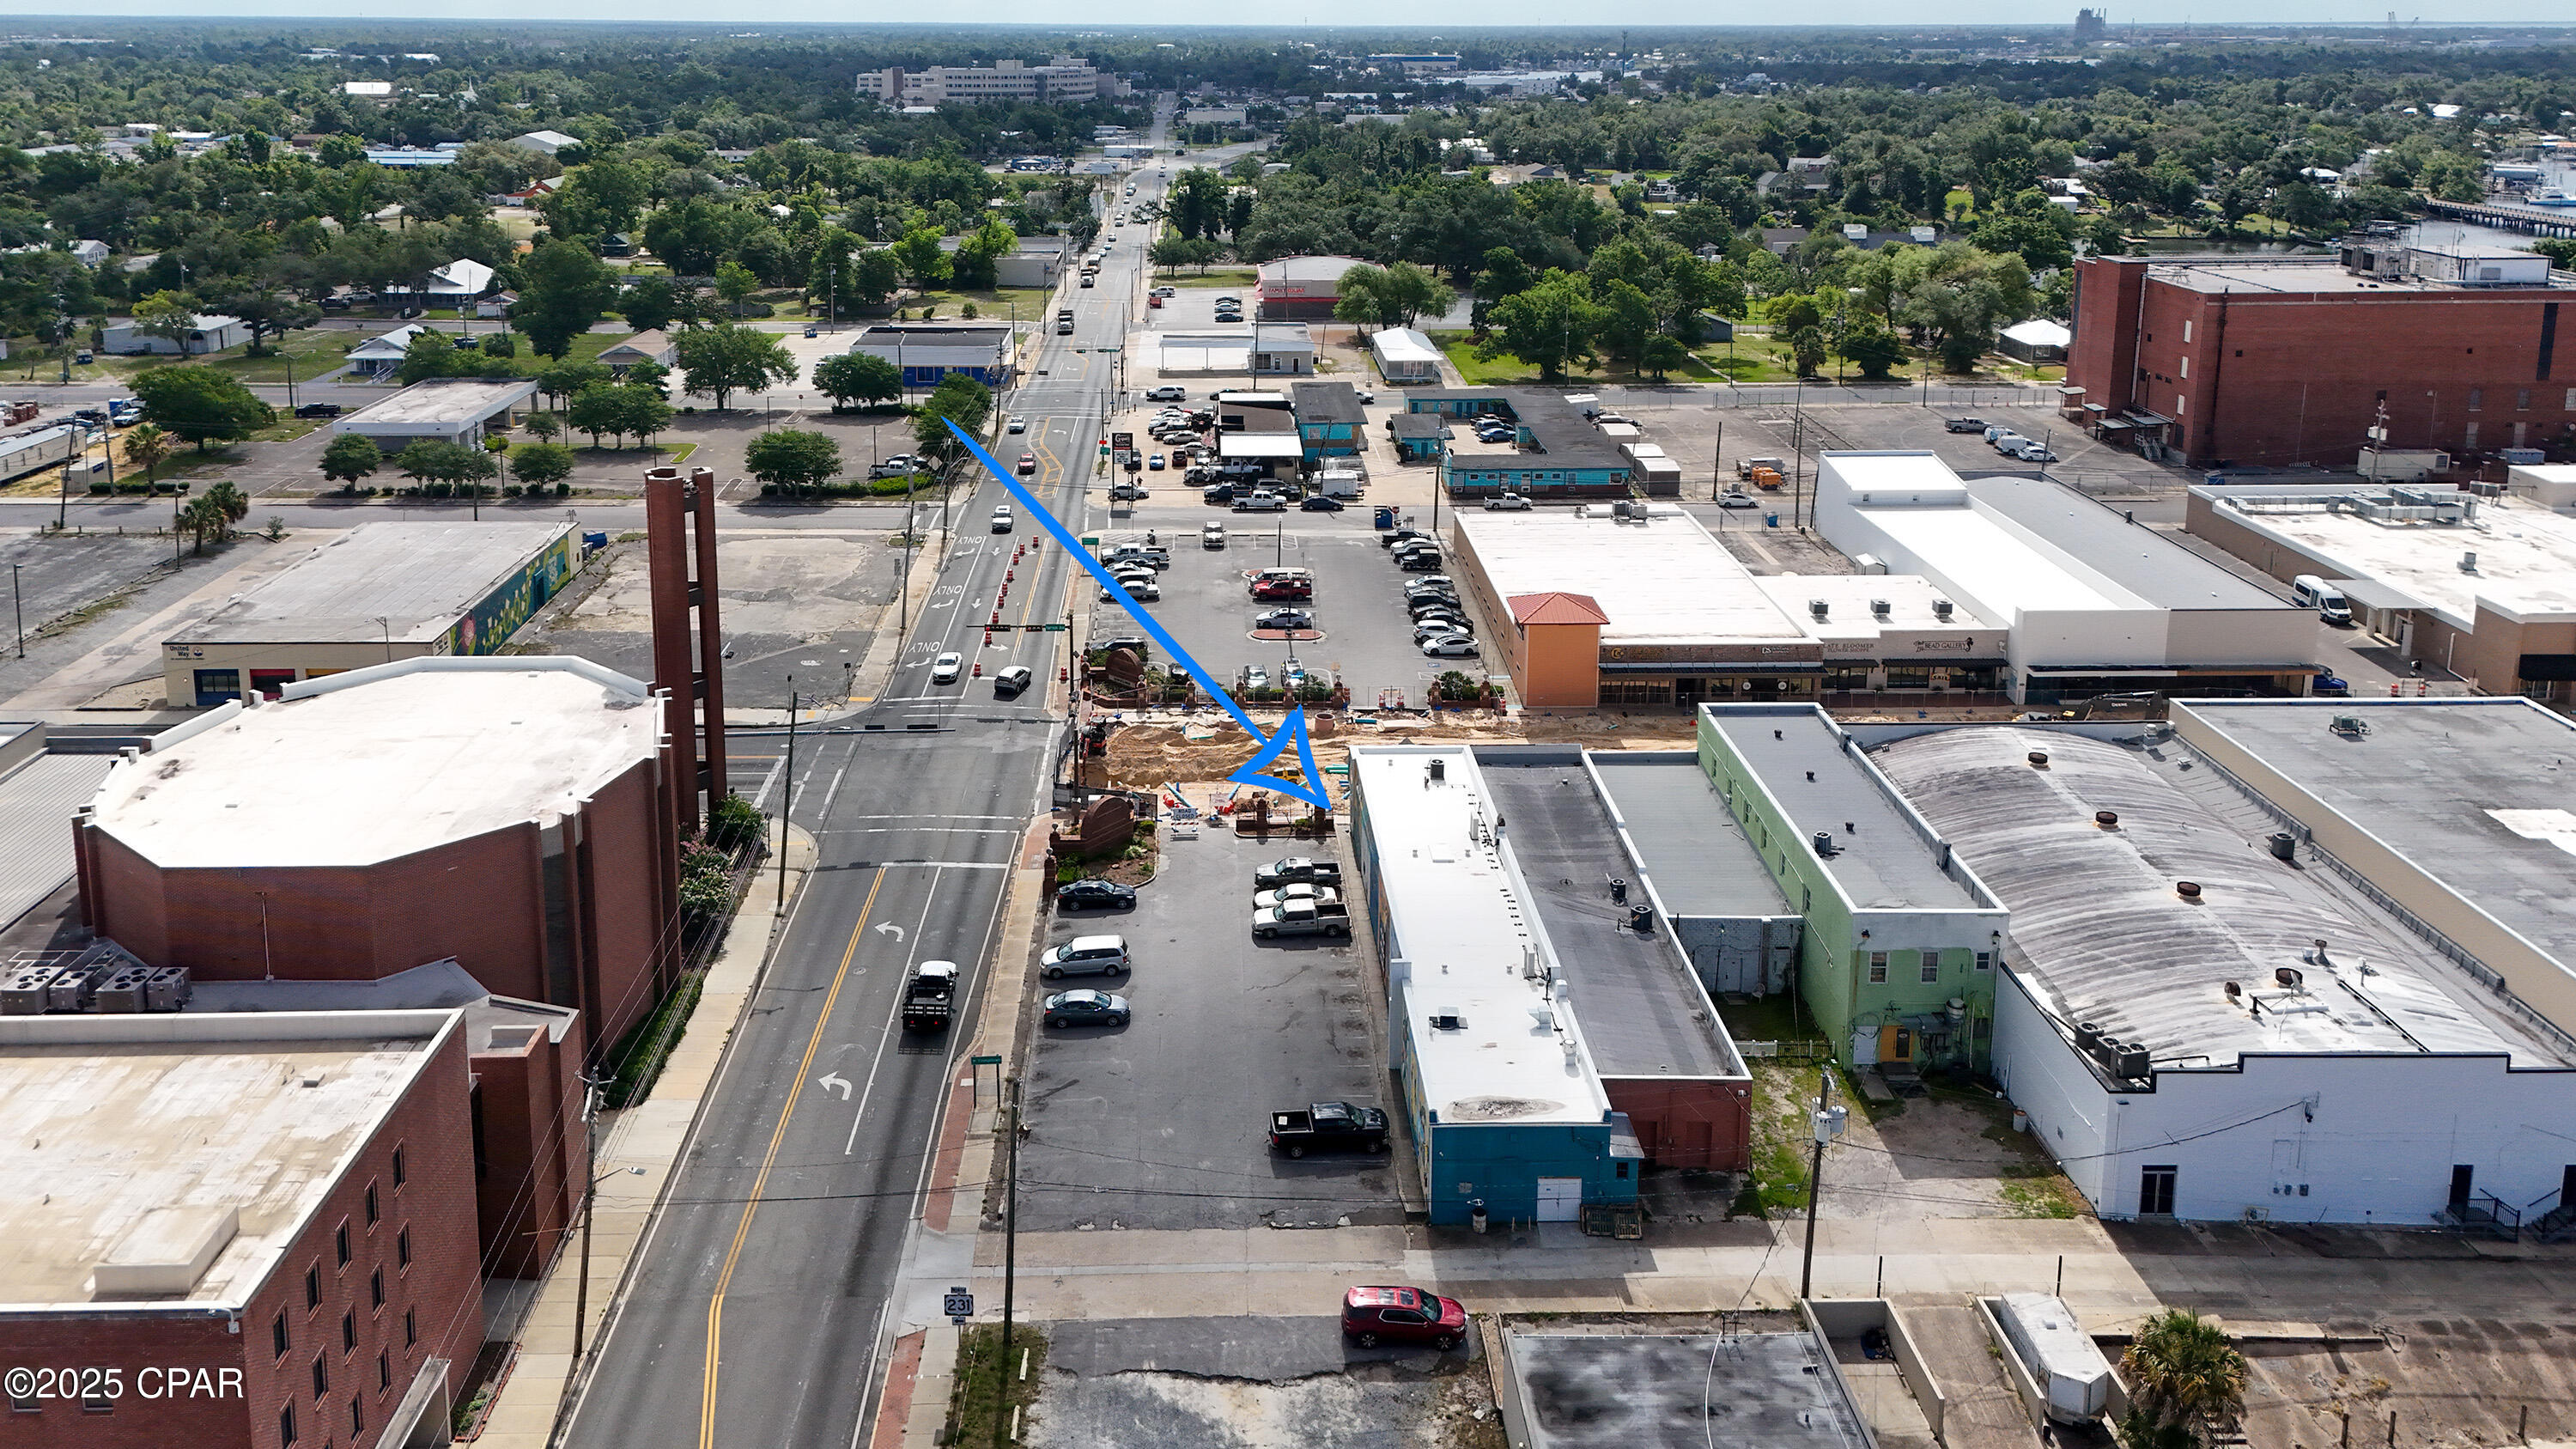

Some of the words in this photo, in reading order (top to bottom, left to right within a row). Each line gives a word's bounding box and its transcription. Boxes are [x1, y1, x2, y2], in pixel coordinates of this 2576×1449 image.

[957, 535, 983, 545] ONLY
[933, 585, 963, 596] ONLY
[908, 641, 941, 653] ONLY
[947, 1299, 970, 1312] 231
